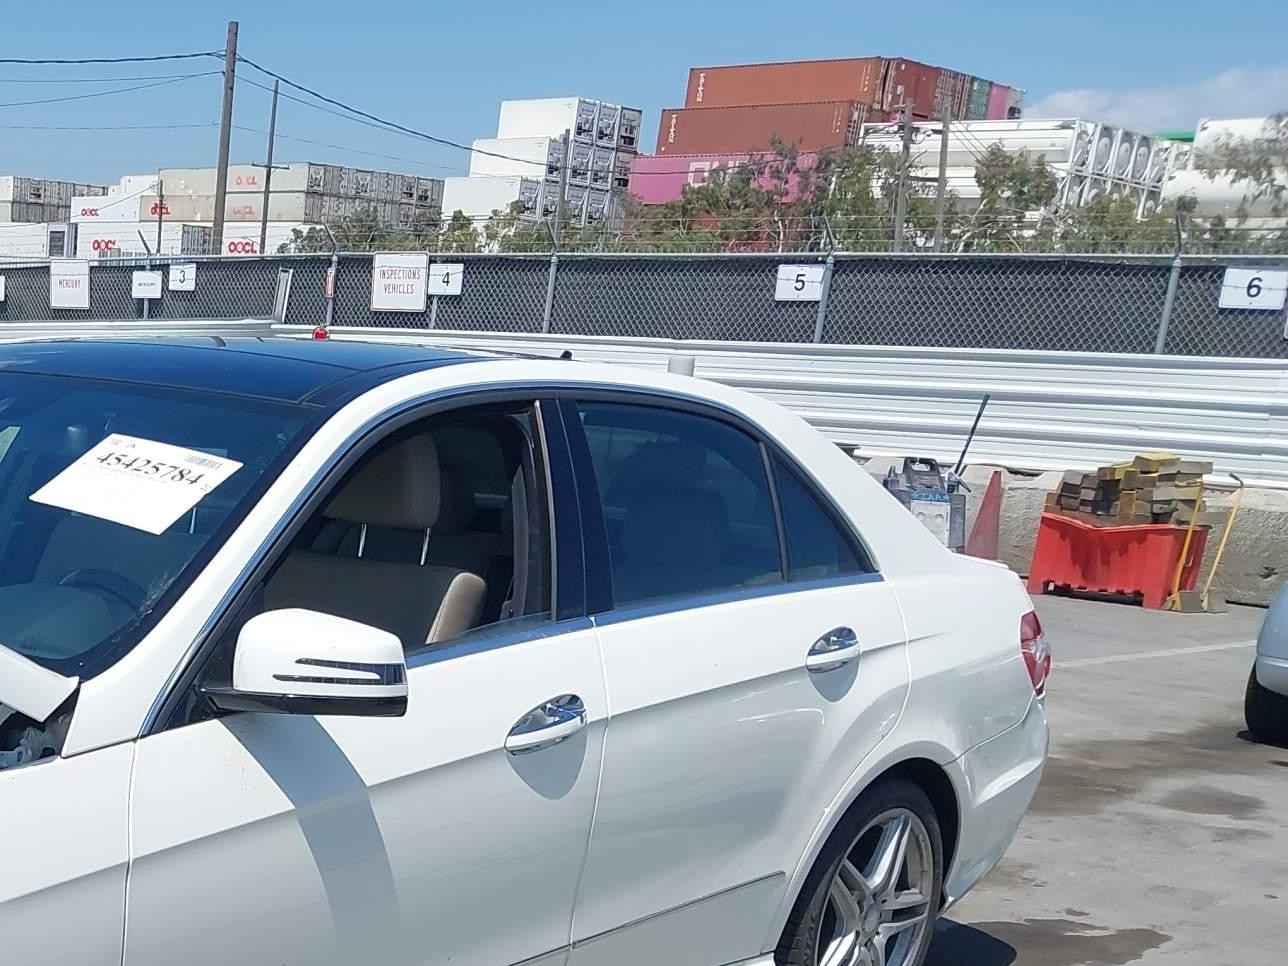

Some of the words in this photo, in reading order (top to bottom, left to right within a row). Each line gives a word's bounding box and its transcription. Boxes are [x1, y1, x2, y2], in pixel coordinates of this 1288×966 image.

[235, 175, 257, 185] OCL
[228, 241, 257, 254] OOCL
[178, 270, 186, 284] 3
[379, 269, 421, 280] INSPECTIONS
[441, 272, 450, 287] 4
[383, 283, 415, 295] VEHICLES
[794, 273, 806, 291] 5
[1246, 276, 1263, 298] 6
[96, 452, 205, 485] 45425784
